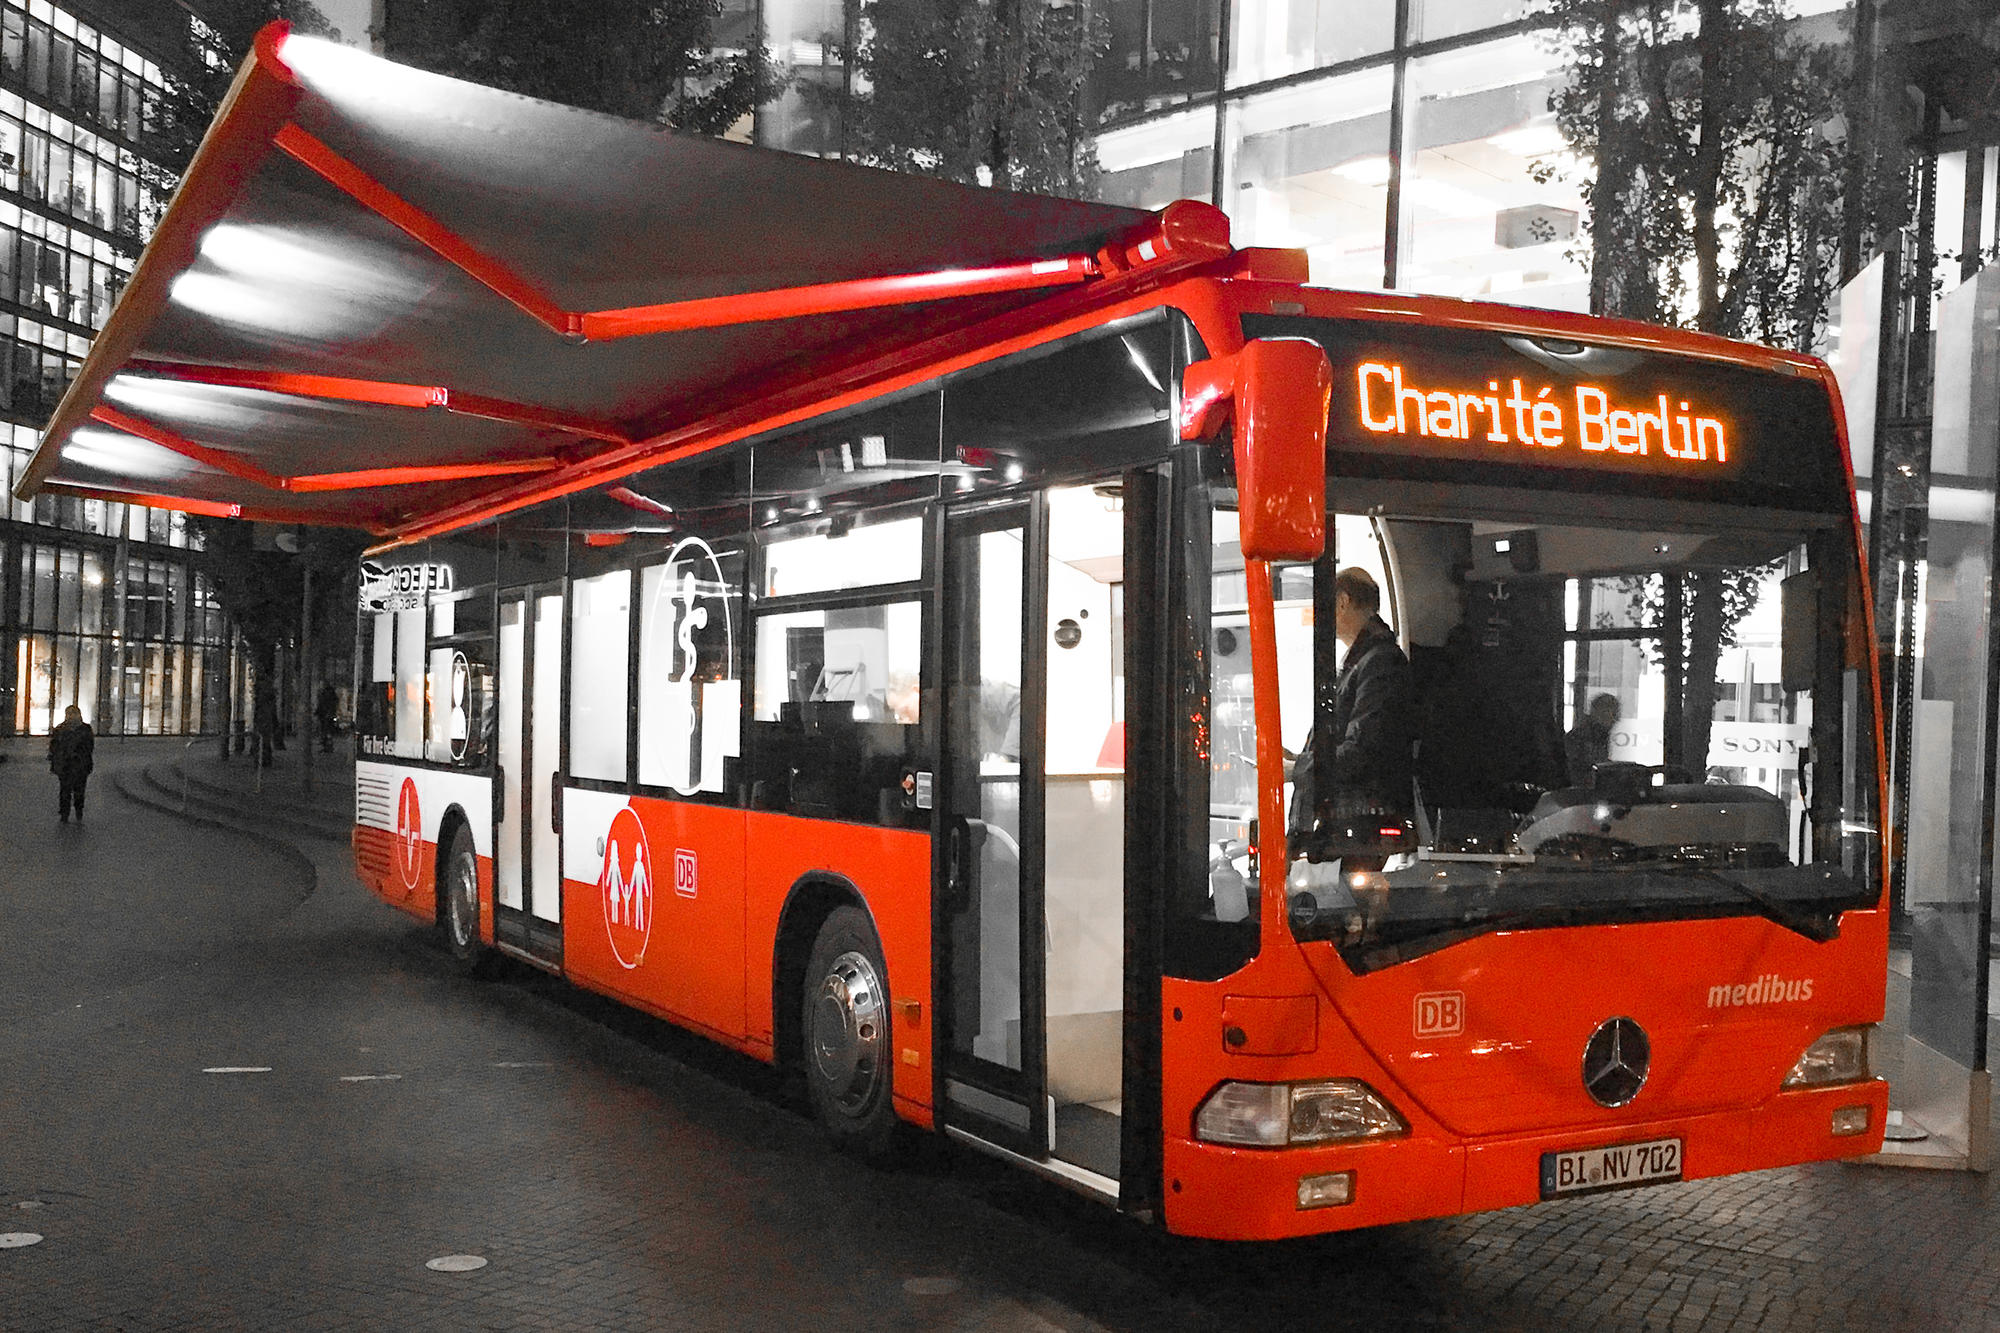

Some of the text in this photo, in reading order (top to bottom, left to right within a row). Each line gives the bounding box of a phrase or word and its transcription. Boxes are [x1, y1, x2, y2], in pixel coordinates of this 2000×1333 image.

[1357, 362, 1727, 462] Charité Berlin
[1723, 737, 1798, 755] SONY
[677, 854, 695, 892] DB
[1707, 973, 1813, 1008] medibus
[1418, 997, 1460, 1032] DB
[1559, 1155, 1587, 1187] BI
[1603, 1150, 1632, 1180] NV
[1637, 1144, 1677, 1175] 702
